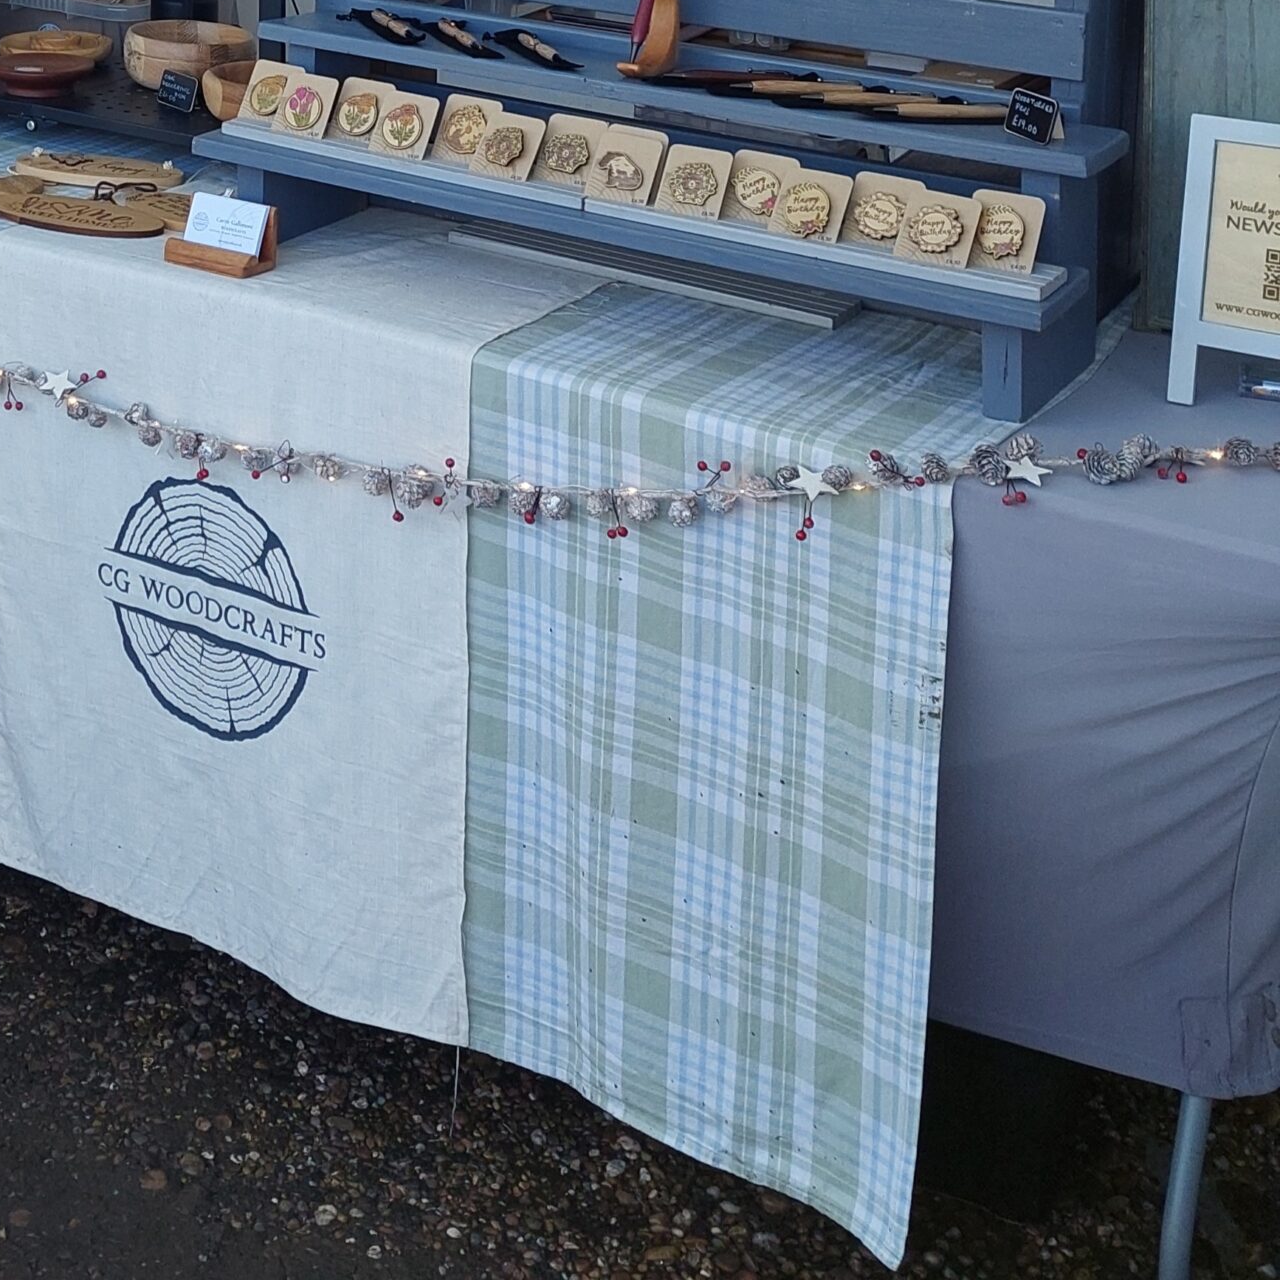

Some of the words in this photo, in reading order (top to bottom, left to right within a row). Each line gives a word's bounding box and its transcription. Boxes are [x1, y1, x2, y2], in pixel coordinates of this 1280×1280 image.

[1229, 199, 1267, 215] Would
[97, 562, 131, 594] CG
[139, 572, 327, 660] WOODCRAFTS
